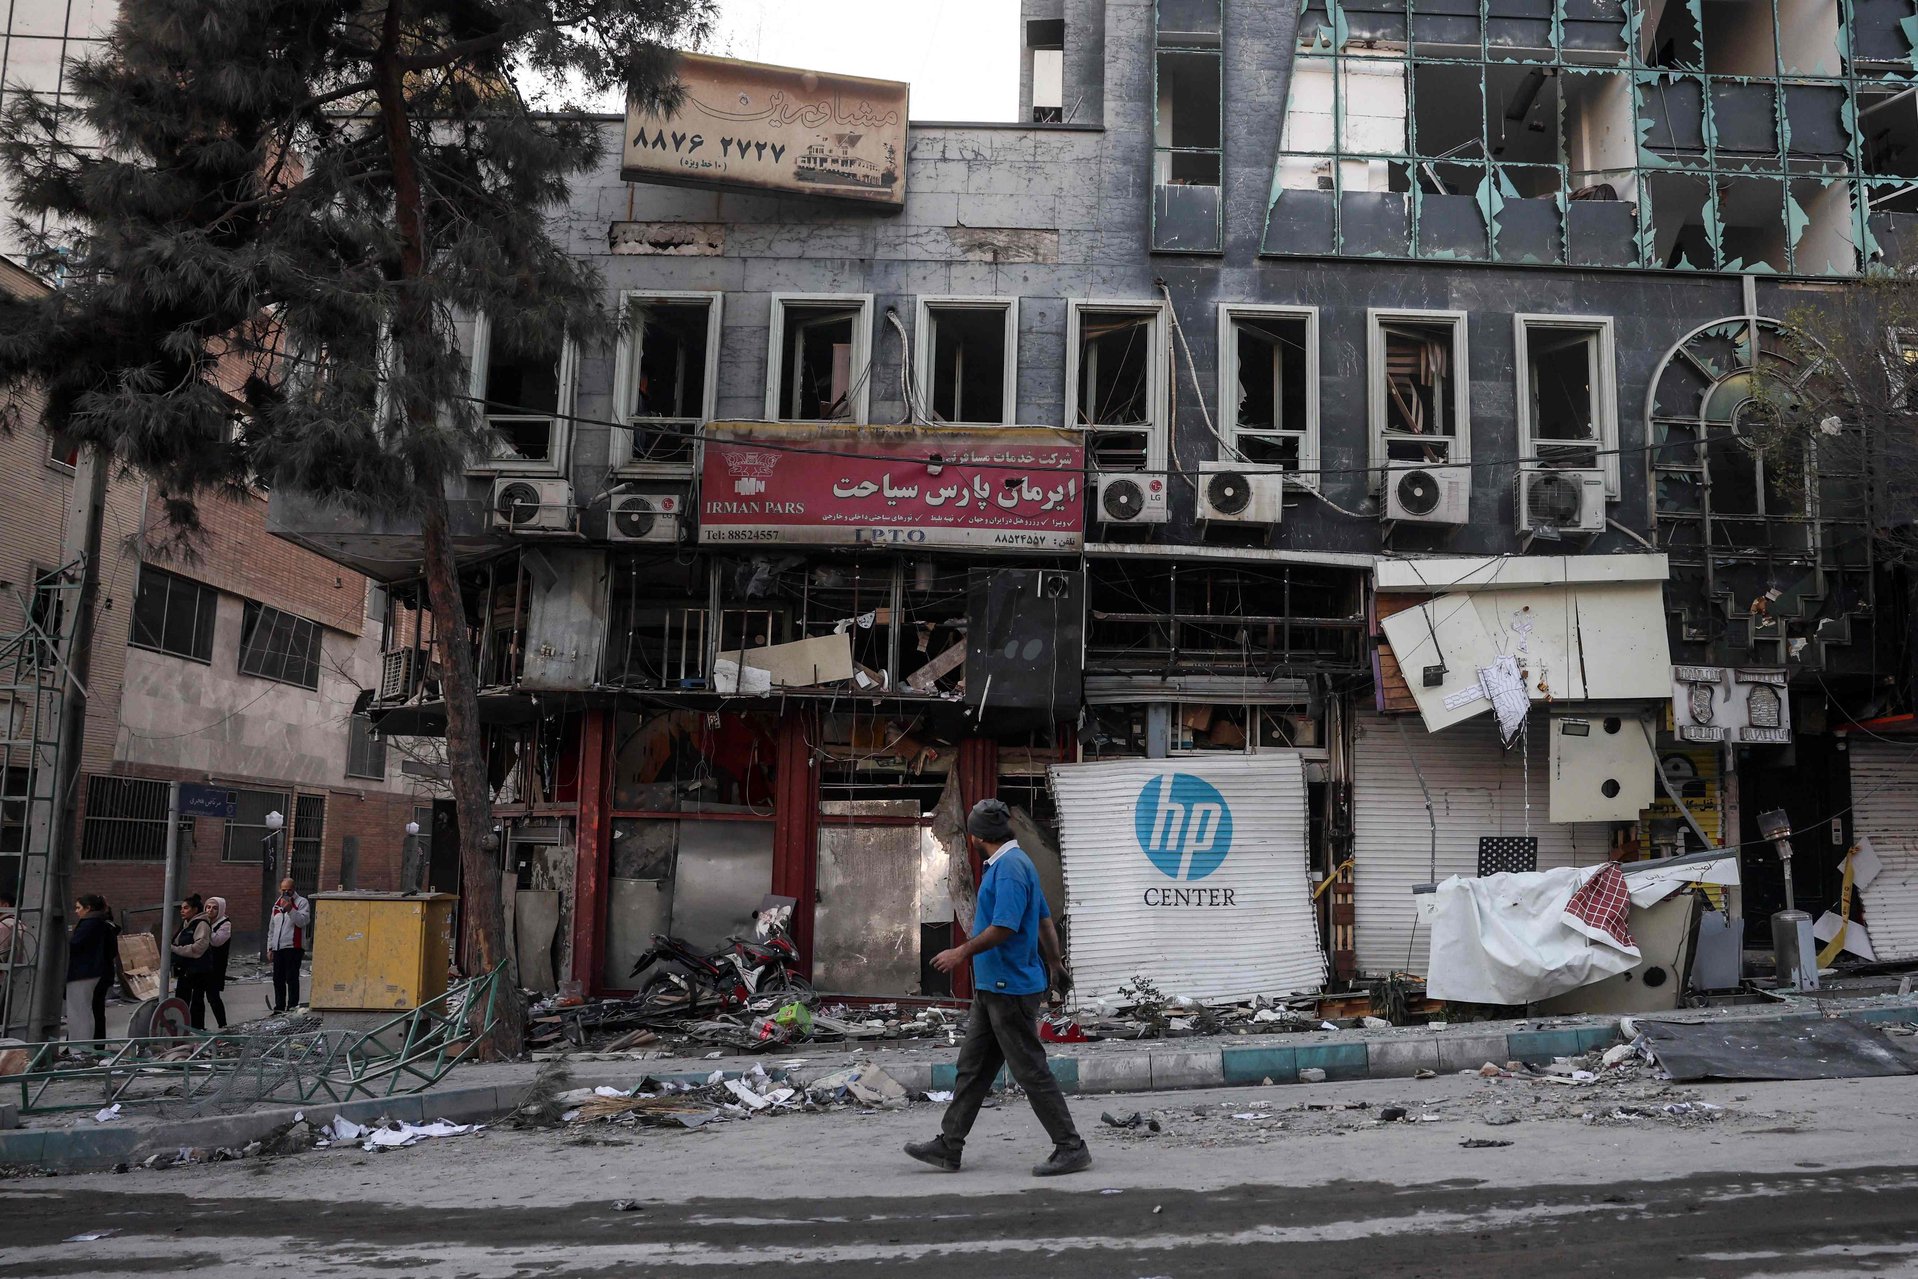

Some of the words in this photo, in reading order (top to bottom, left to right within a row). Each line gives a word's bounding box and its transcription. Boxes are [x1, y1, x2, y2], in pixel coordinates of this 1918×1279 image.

[633, 126, 704, 154] ۸۸۷۶
[720, 135, 786, 164] ۲۷۲۷
[993, 450, 1035, 464] خدمات
[1038, 451, 1073, 468] شرکت
[832, 472, 919, 507] سیاحت
[924, 473, 991, 511] پارس
[996, 474, 1076, 511] ایرمان
[706, 501, 760, 514] IRMAN
[765, 502, 805, 515] PARS
[705, 529, 725, 540] Tel:
[727, 529, 779, 540] 88524557
[1148, 772, 1223, 881] hp
[1143, 887, 1237, 907] CENTER
